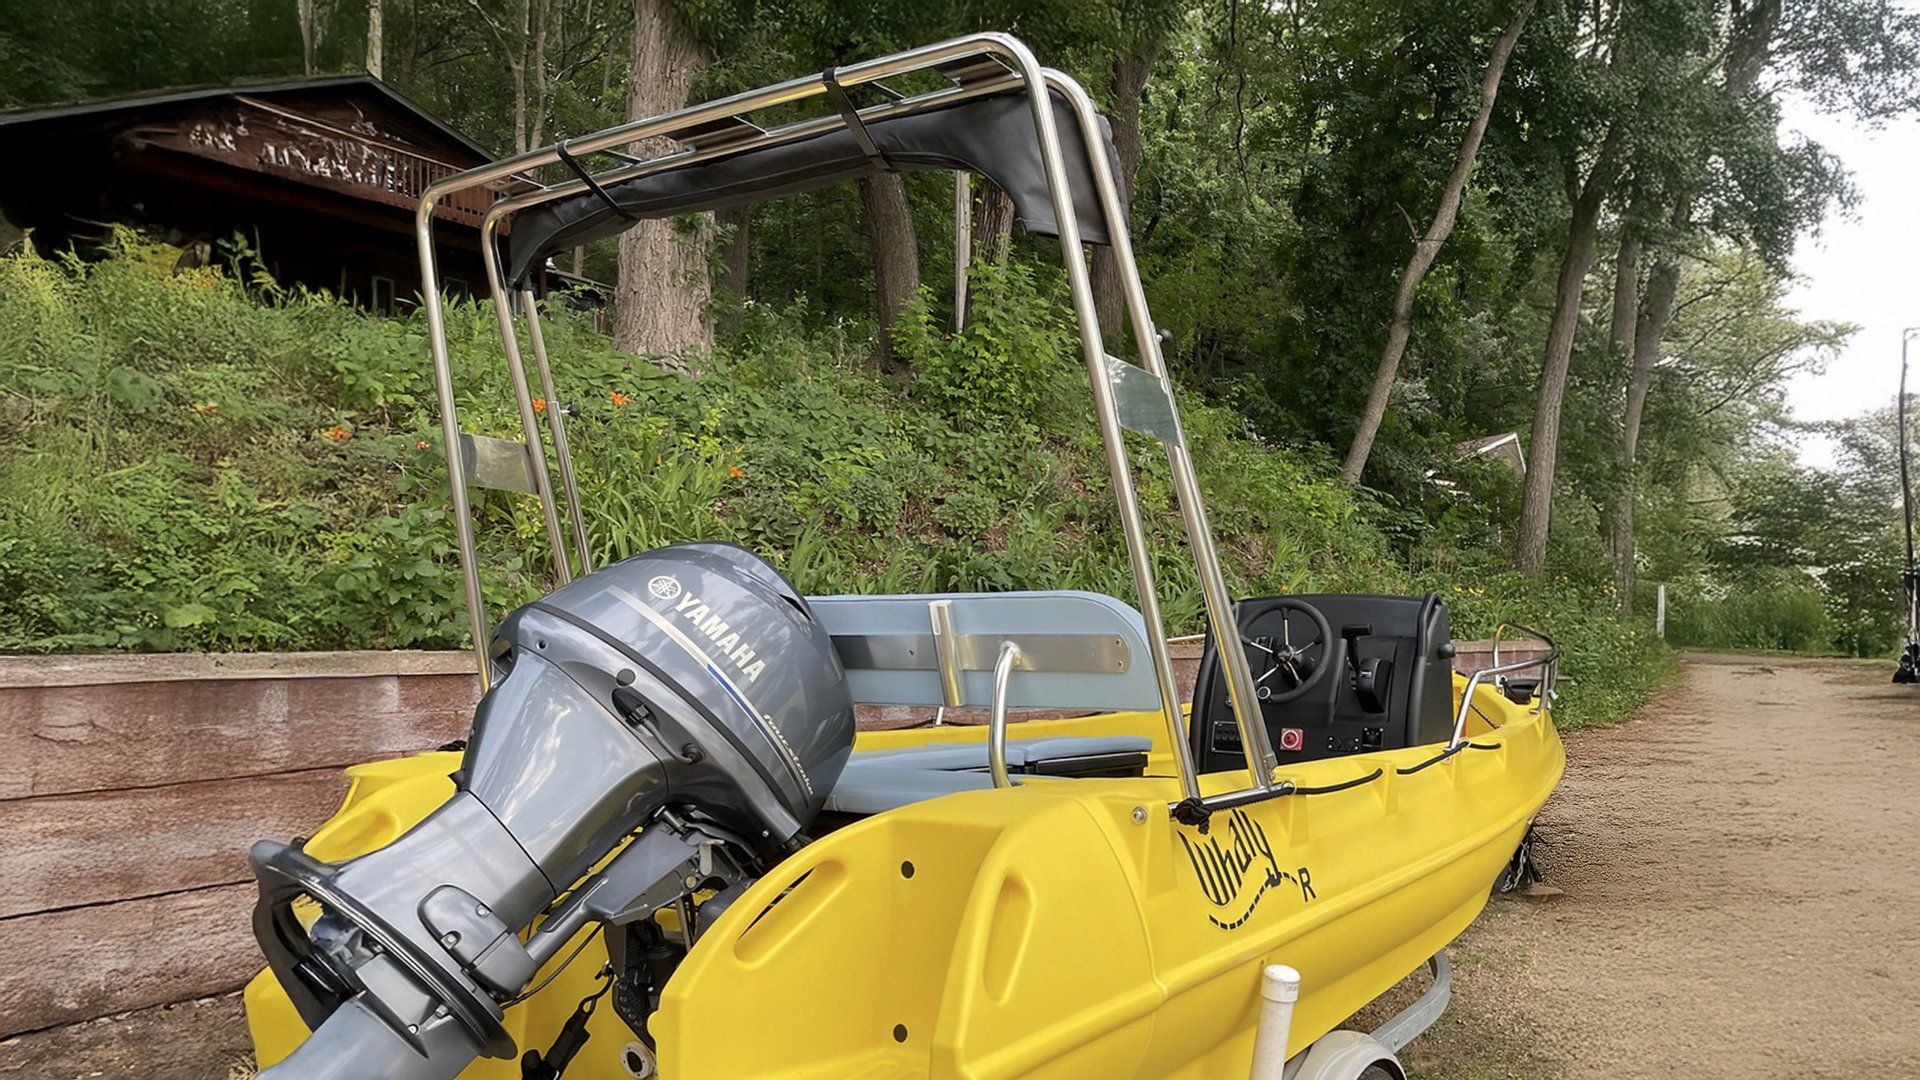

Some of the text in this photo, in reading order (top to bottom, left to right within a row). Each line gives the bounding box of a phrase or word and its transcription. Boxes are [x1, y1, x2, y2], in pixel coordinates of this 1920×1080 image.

[675, 592, 767, 683] YAMAHA
[1177, 808, 1317, 906] Whally R
